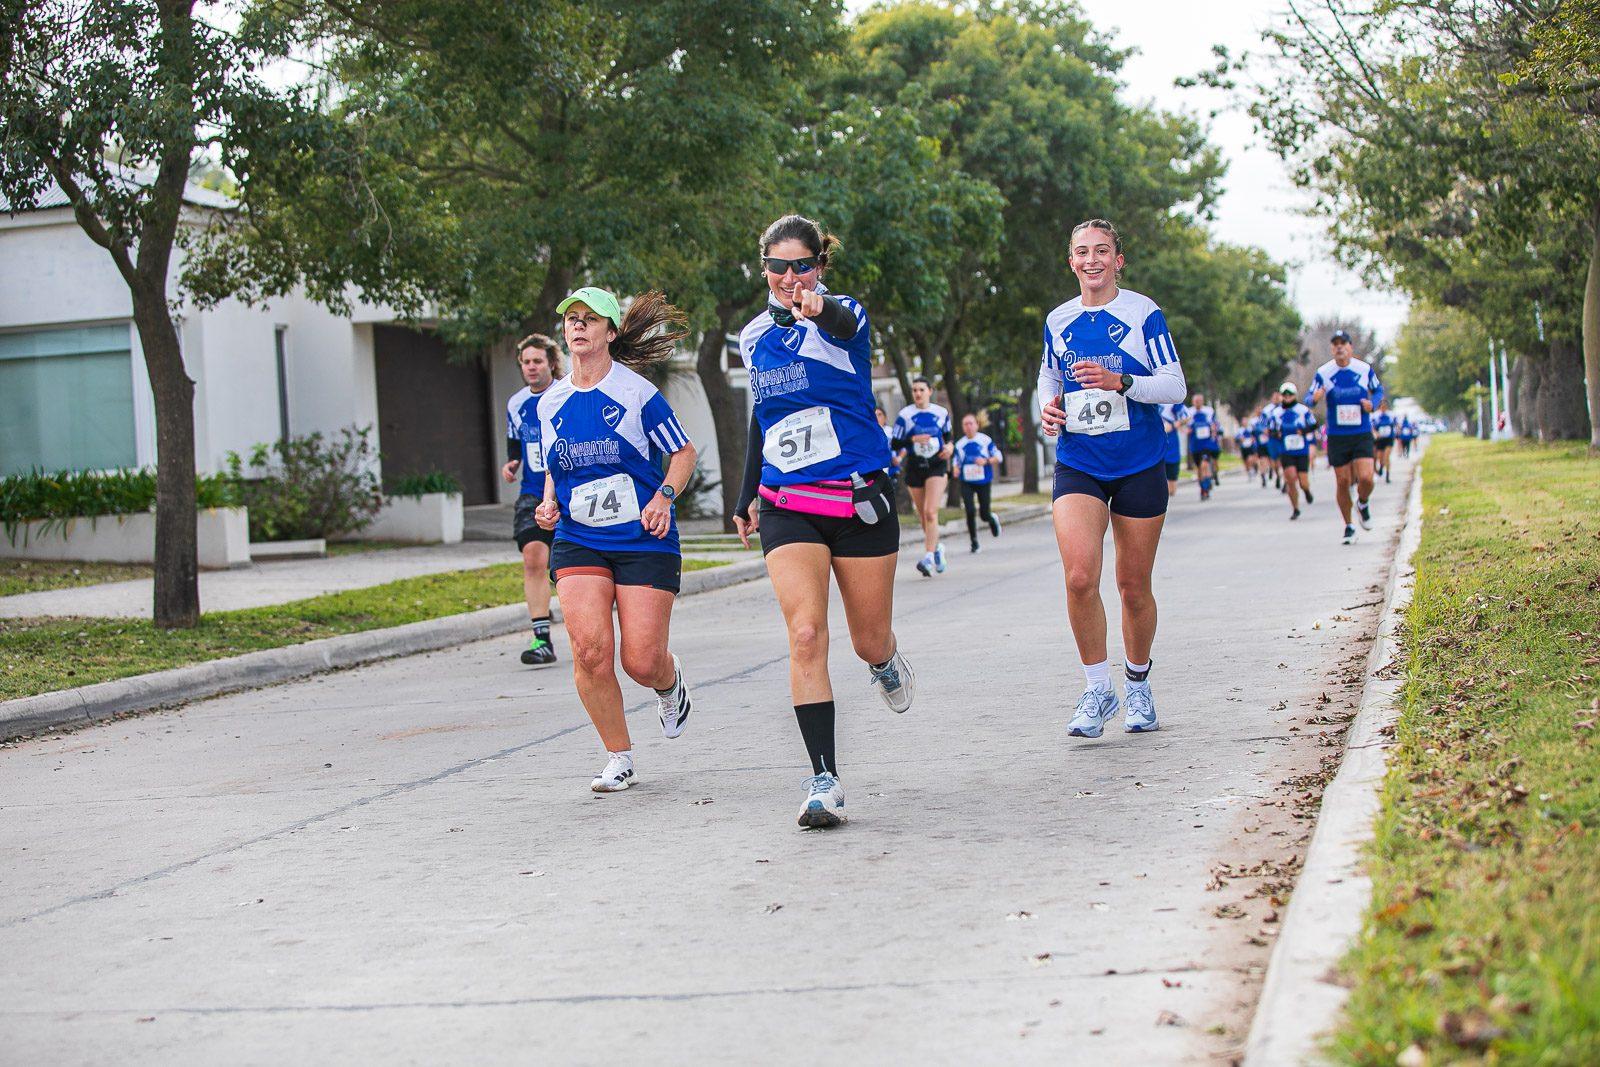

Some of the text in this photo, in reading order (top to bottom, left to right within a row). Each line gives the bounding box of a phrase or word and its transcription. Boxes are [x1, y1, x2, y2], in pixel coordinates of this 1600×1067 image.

[1064, 350, 1078, 382] 3
[749, 362, 807, 404] 3 MARATÓN
[1078, 401, 1112, 424] 49
[555, 438, 620, 471] 3 MARATÓN
[778, 425, 813, 458] 57
[584, 489, 622, 518] 74
